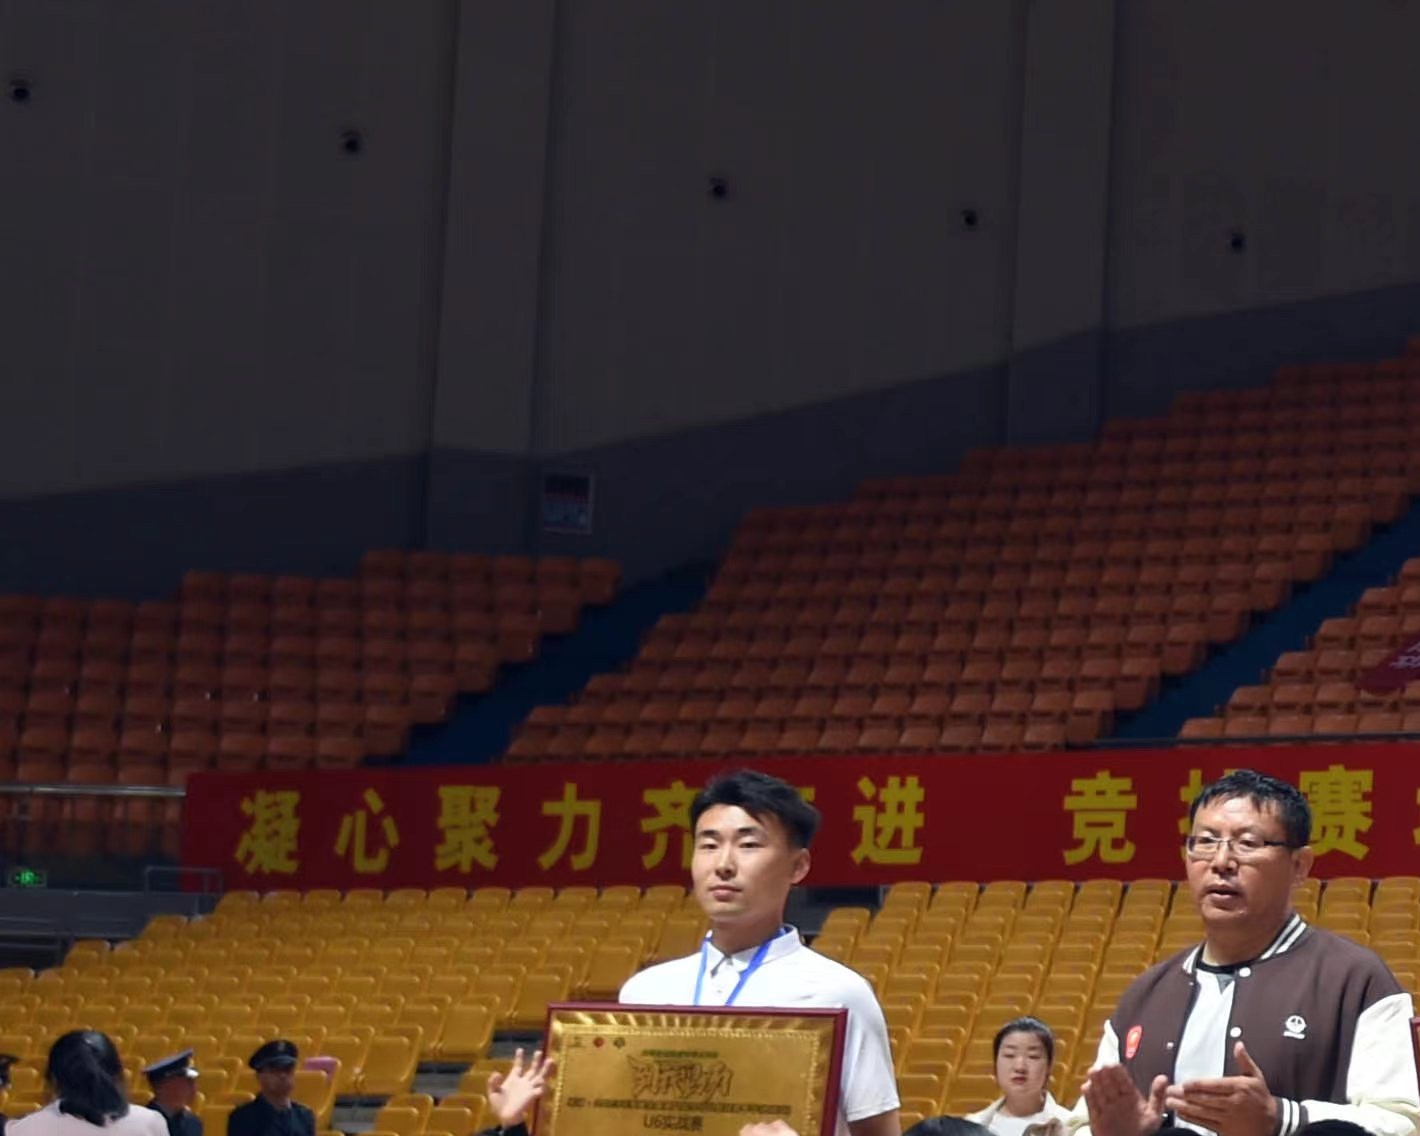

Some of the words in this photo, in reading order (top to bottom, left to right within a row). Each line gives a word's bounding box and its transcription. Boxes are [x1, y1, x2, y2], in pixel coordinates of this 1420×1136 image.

[235, 776, 925, 875] 凝心聚力齐进
